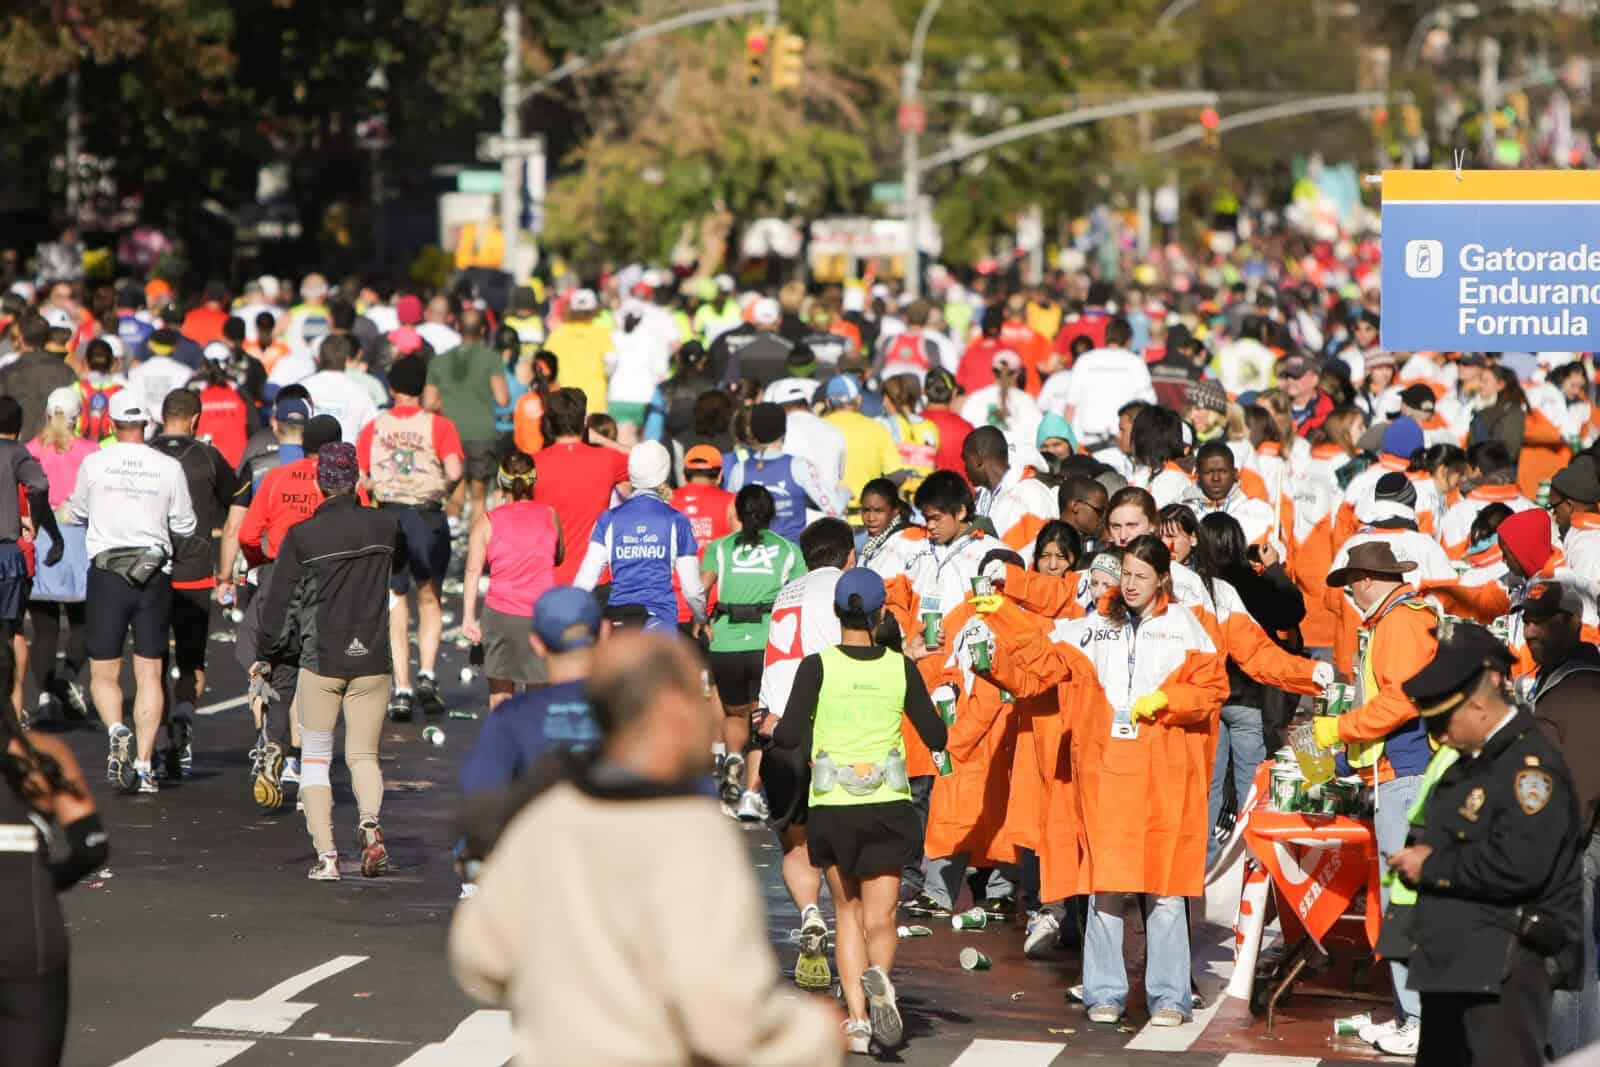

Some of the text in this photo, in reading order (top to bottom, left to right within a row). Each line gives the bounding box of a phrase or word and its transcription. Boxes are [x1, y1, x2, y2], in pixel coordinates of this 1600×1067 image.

[1459, 243, 1600, 272] Gatorade
[1459, 307, 1588, 336] Formula
[615, 545, 666, 560] DERNAU
[1298, 853, 1343, 921] SERIES
